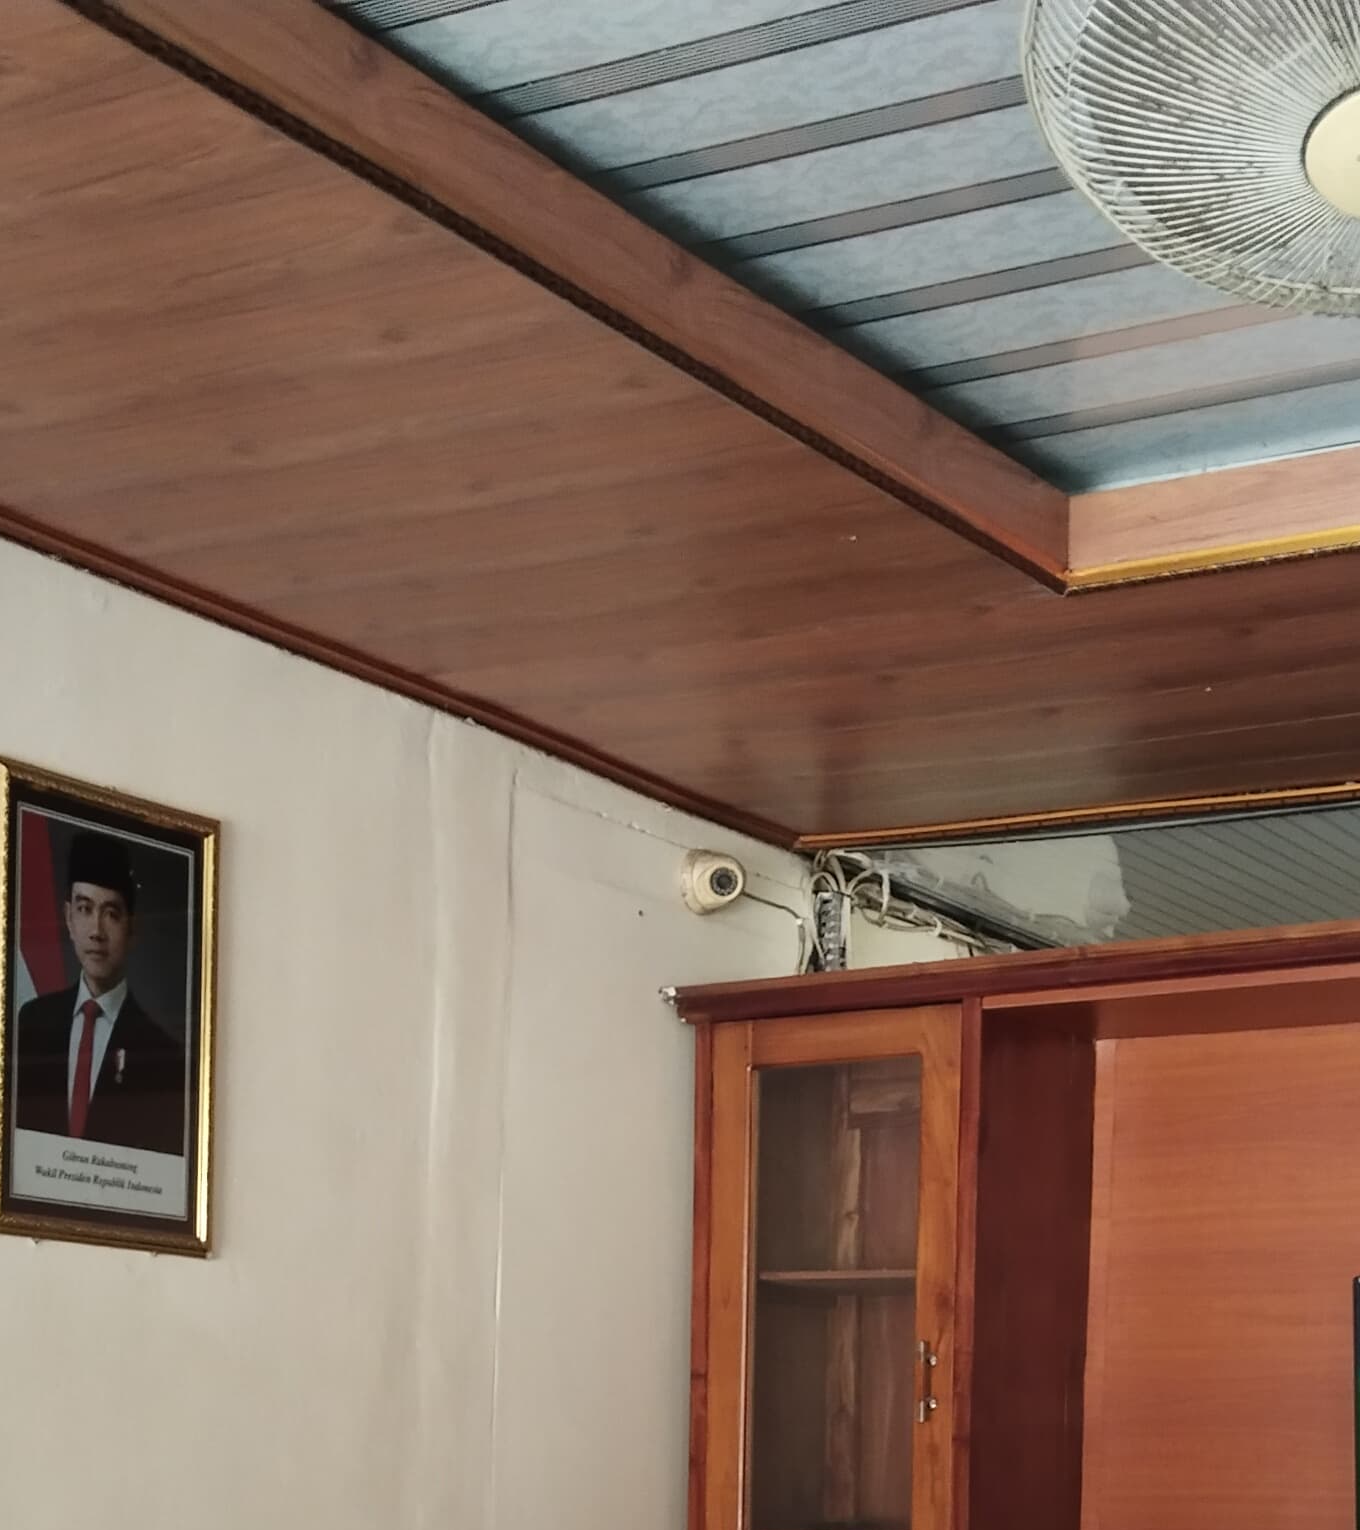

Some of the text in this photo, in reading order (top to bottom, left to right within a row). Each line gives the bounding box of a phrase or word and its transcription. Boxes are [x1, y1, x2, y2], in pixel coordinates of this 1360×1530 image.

[58, 1169, 91, 1184] Presiden
[92, 1175, 125, 1190] Republik
[127, 1180, 163, 1196] Indonesia
